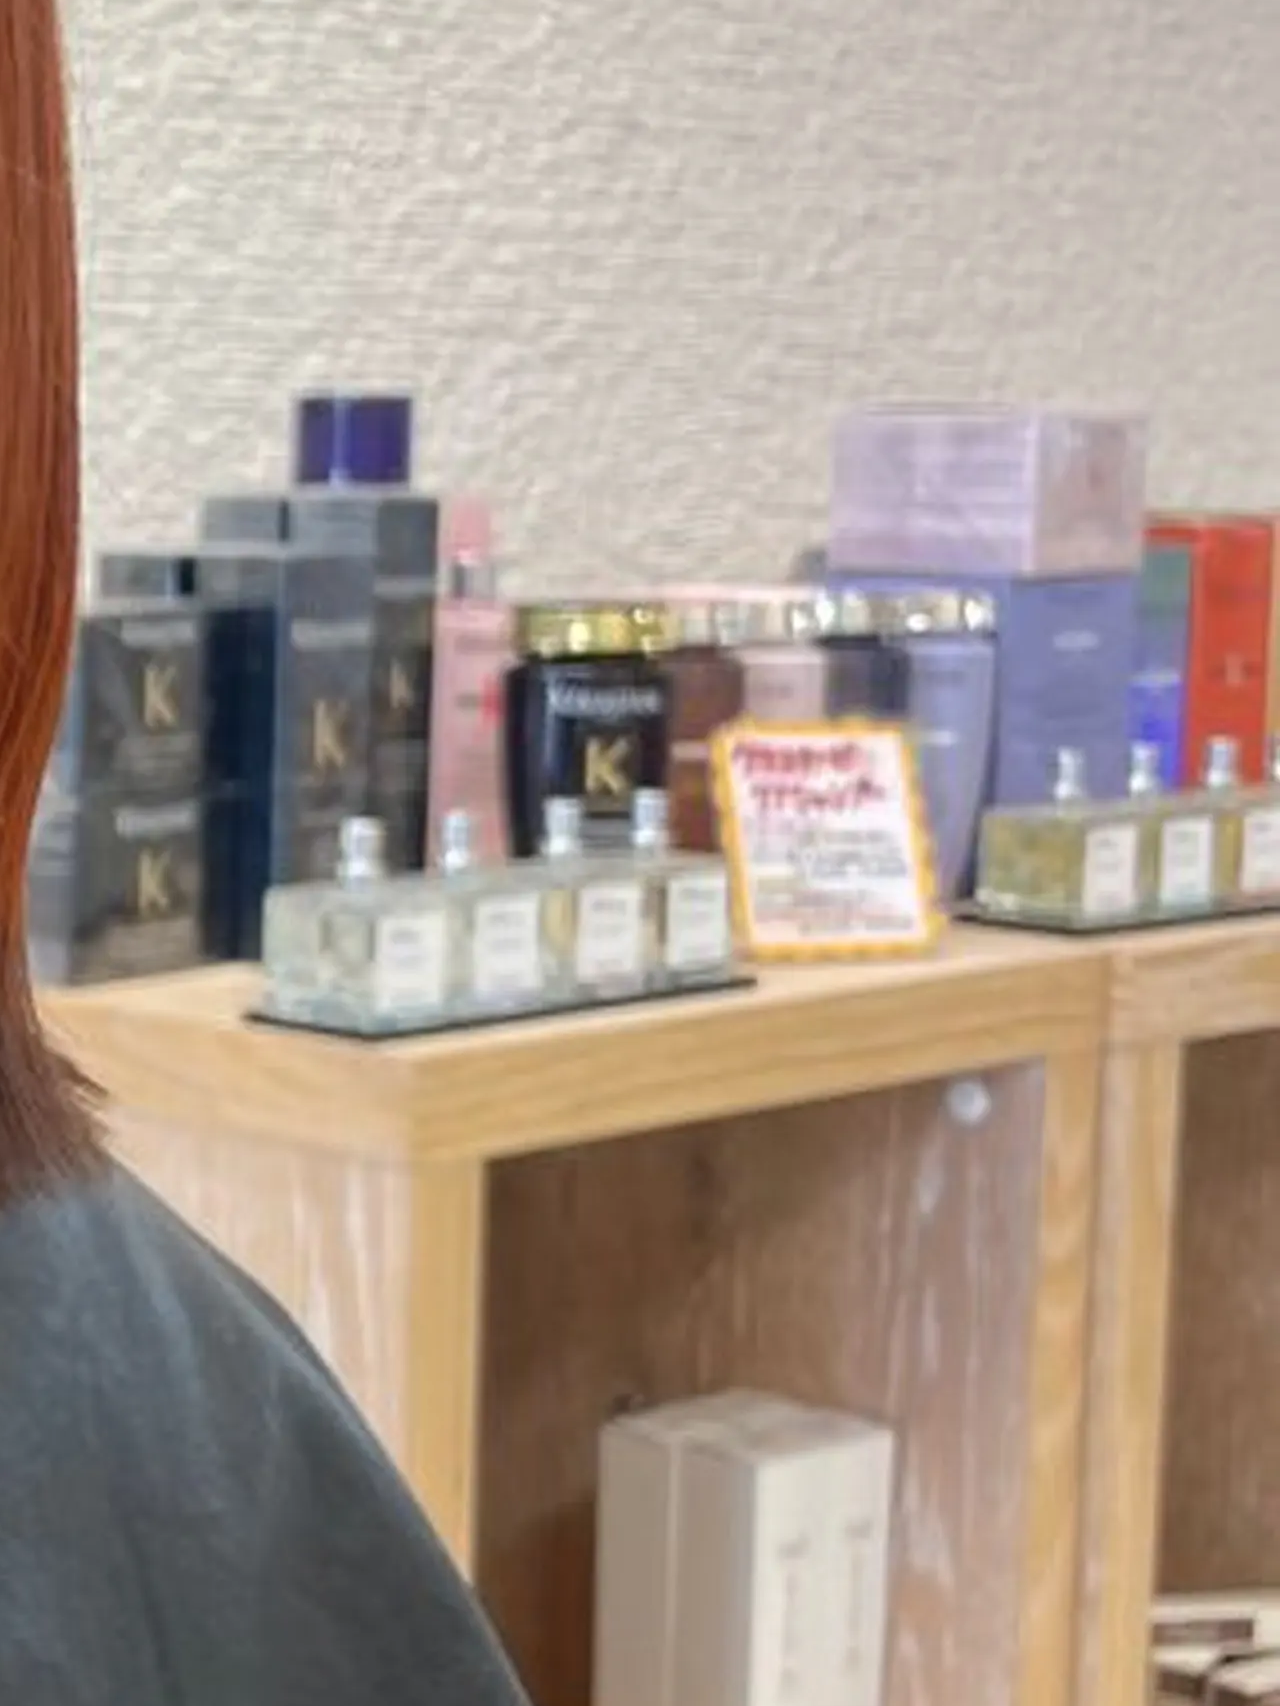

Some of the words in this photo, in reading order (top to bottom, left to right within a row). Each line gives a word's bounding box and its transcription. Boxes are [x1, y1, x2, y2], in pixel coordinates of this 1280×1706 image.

[144, 663, 178, 729] K
[585, 736, 631, 794] K
[138, 849, 171, 913] K
